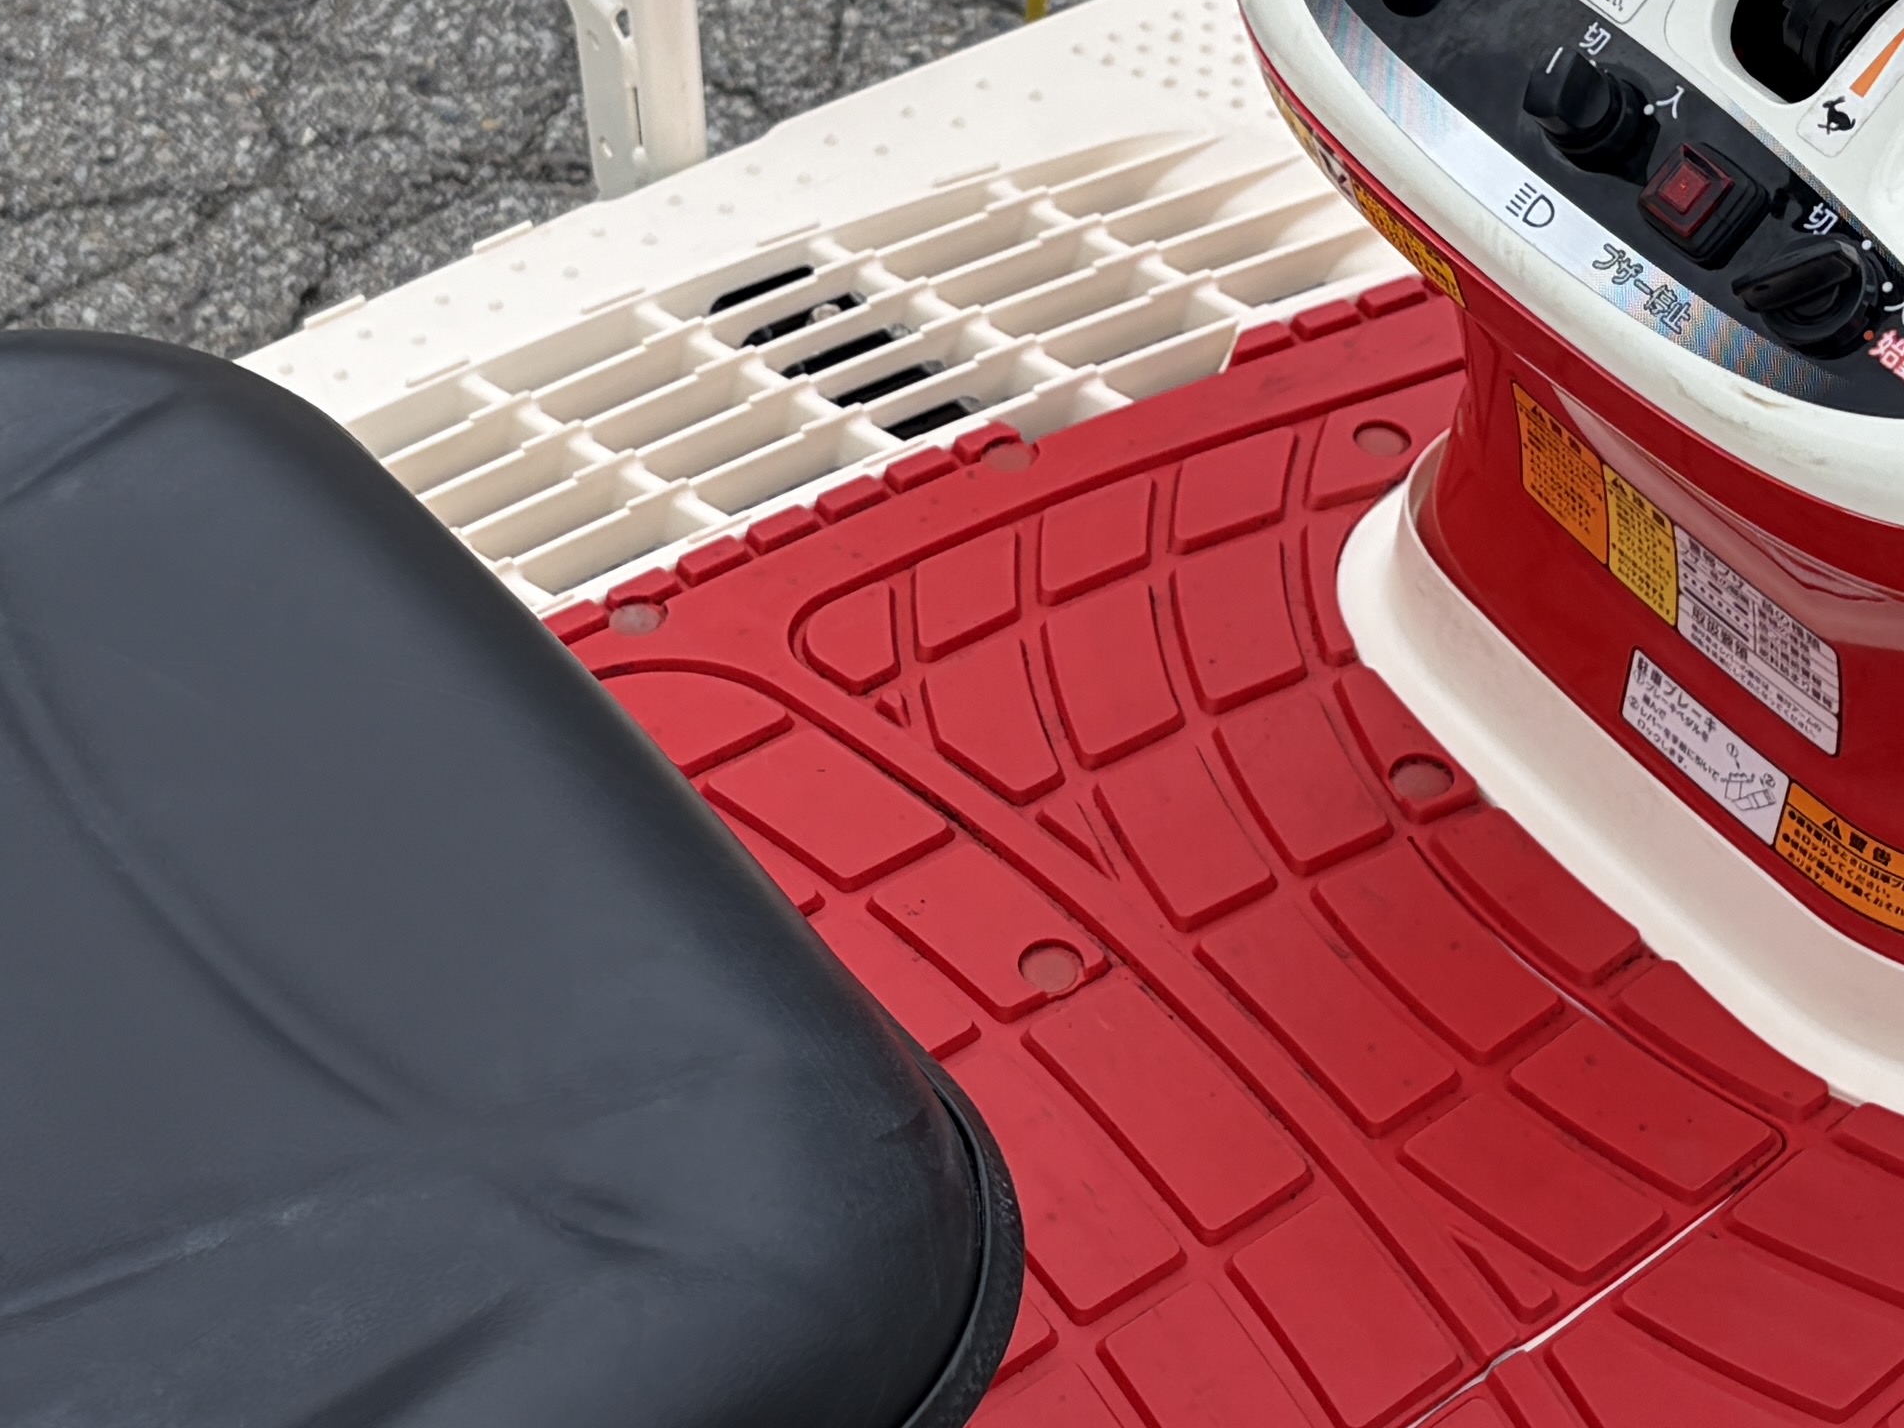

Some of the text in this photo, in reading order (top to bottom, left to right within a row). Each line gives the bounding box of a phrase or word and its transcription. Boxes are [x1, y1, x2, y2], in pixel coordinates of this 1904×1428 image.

[1579, 21, 1611, 55] 切
[1656, 85, 1685, 119] 入
[1804, 203, 1838, 235] 切
[1592, 243, 1692, 335] ブザー停止
